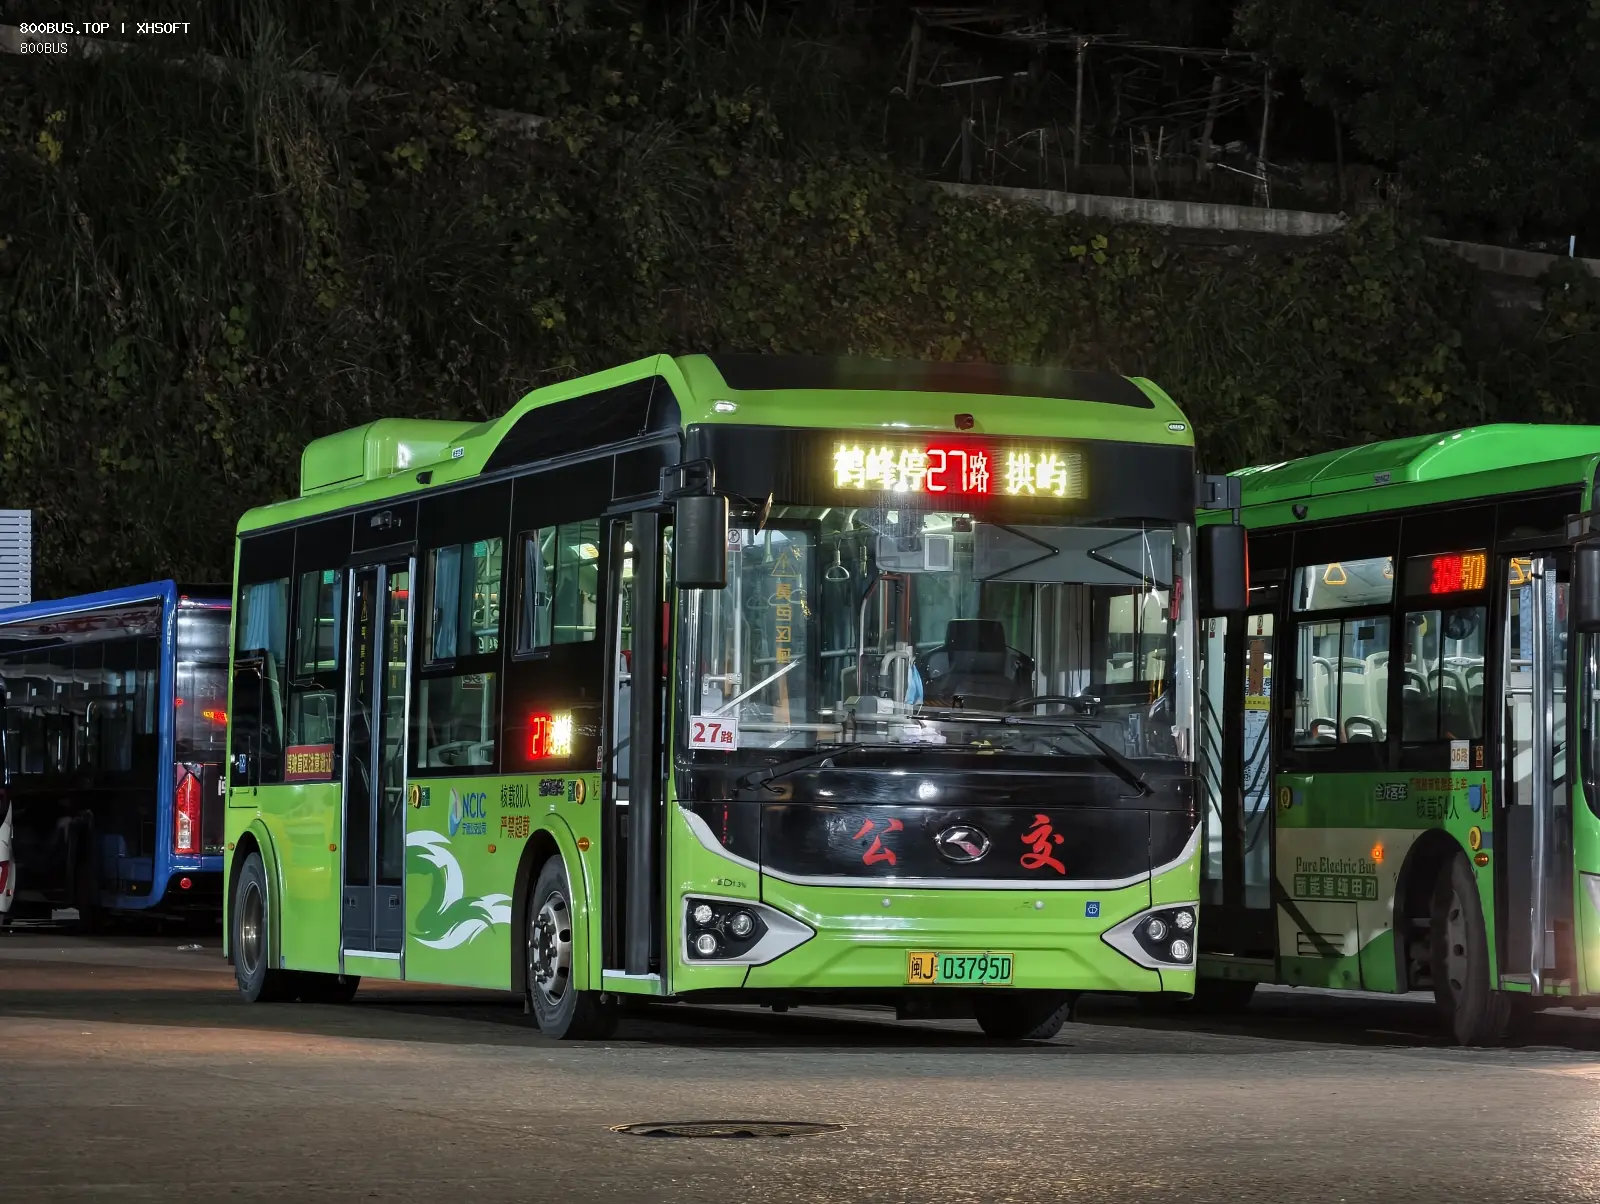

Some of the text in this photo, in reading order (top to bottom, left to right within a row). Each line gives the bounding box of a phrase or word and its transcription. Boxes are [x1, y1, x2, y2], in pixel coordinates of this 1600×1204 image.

[692, 721, 734, 744] 27路
[500, 784, 531, 808] 核载80人
[1375, 783, 1408, 801] 金龙客车
[462, 792, 487, 818] NCIC
[1416, 795, 1460, 820] 核载54人
[500, 815, 530, 838] 严禁超载
[852, 813, 1067, 875] 公 交
[1296, 856, 1377, 875] Pure Electric Bus
